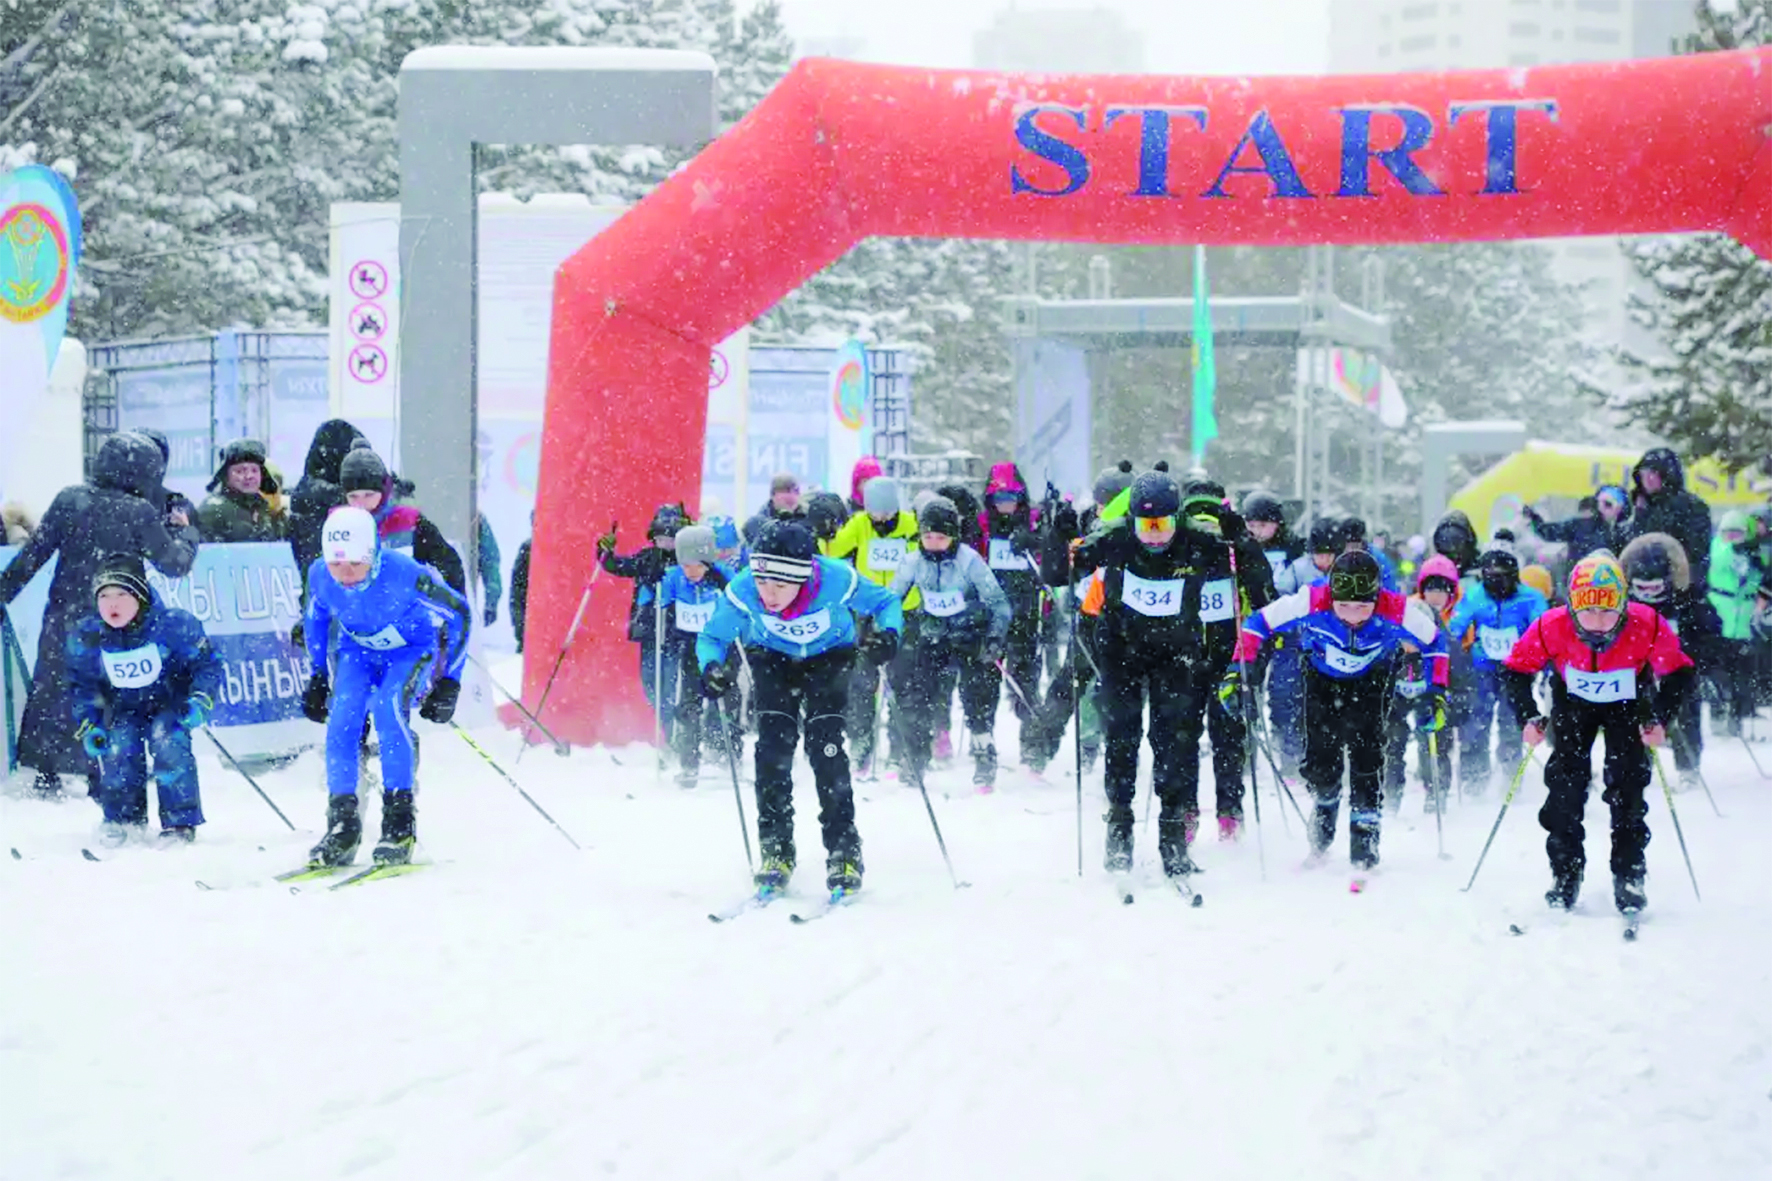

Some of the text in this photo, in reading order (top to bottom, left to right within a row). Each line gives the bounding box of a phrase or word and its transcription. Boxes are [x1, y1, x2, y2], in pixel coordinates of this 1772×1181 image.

[1011, 100, 1559, 198] START
[872, 547, 900, 563] 542
[1130, 588, 1173, 606] 434
[774, 621, 820, 637] 263
[113, 658, 153, 679] 520
[1576, 677, 1620, 694] 271
